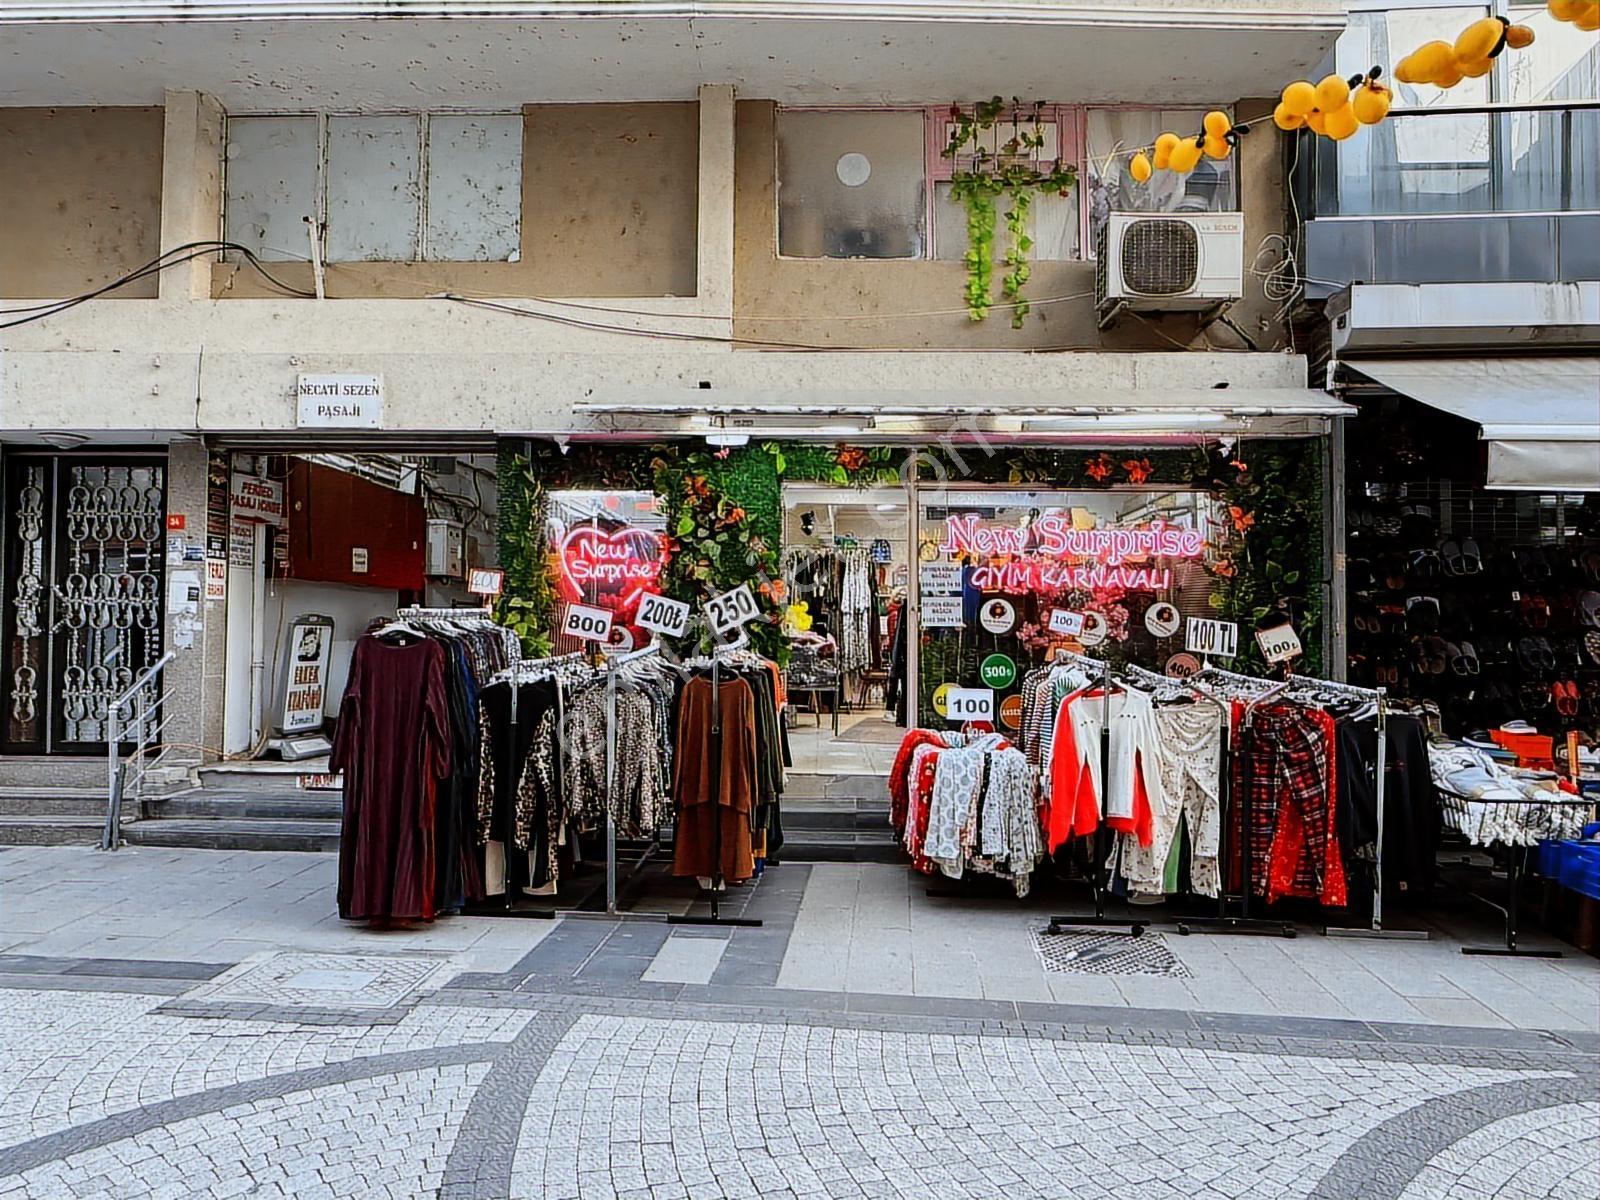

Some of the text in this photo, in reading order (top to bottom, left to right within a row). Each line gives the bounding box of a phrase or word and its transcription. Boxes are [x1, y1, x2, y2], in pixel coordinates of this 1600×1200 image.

[342, 385, 380, 396] SEZEN
[579, 538, 633, 560] New
[939, 514, 1202, 564] New Surprise
[571, 560, 653, 583] Surprise
[1040, 568, 1170, 589] KARNAVALI
[709, 590, 751, 628] 250
[568, 614, 607, 634] 800
[1220, 624, 1235, 653] TL
[953, 699, 990, 713] 100
